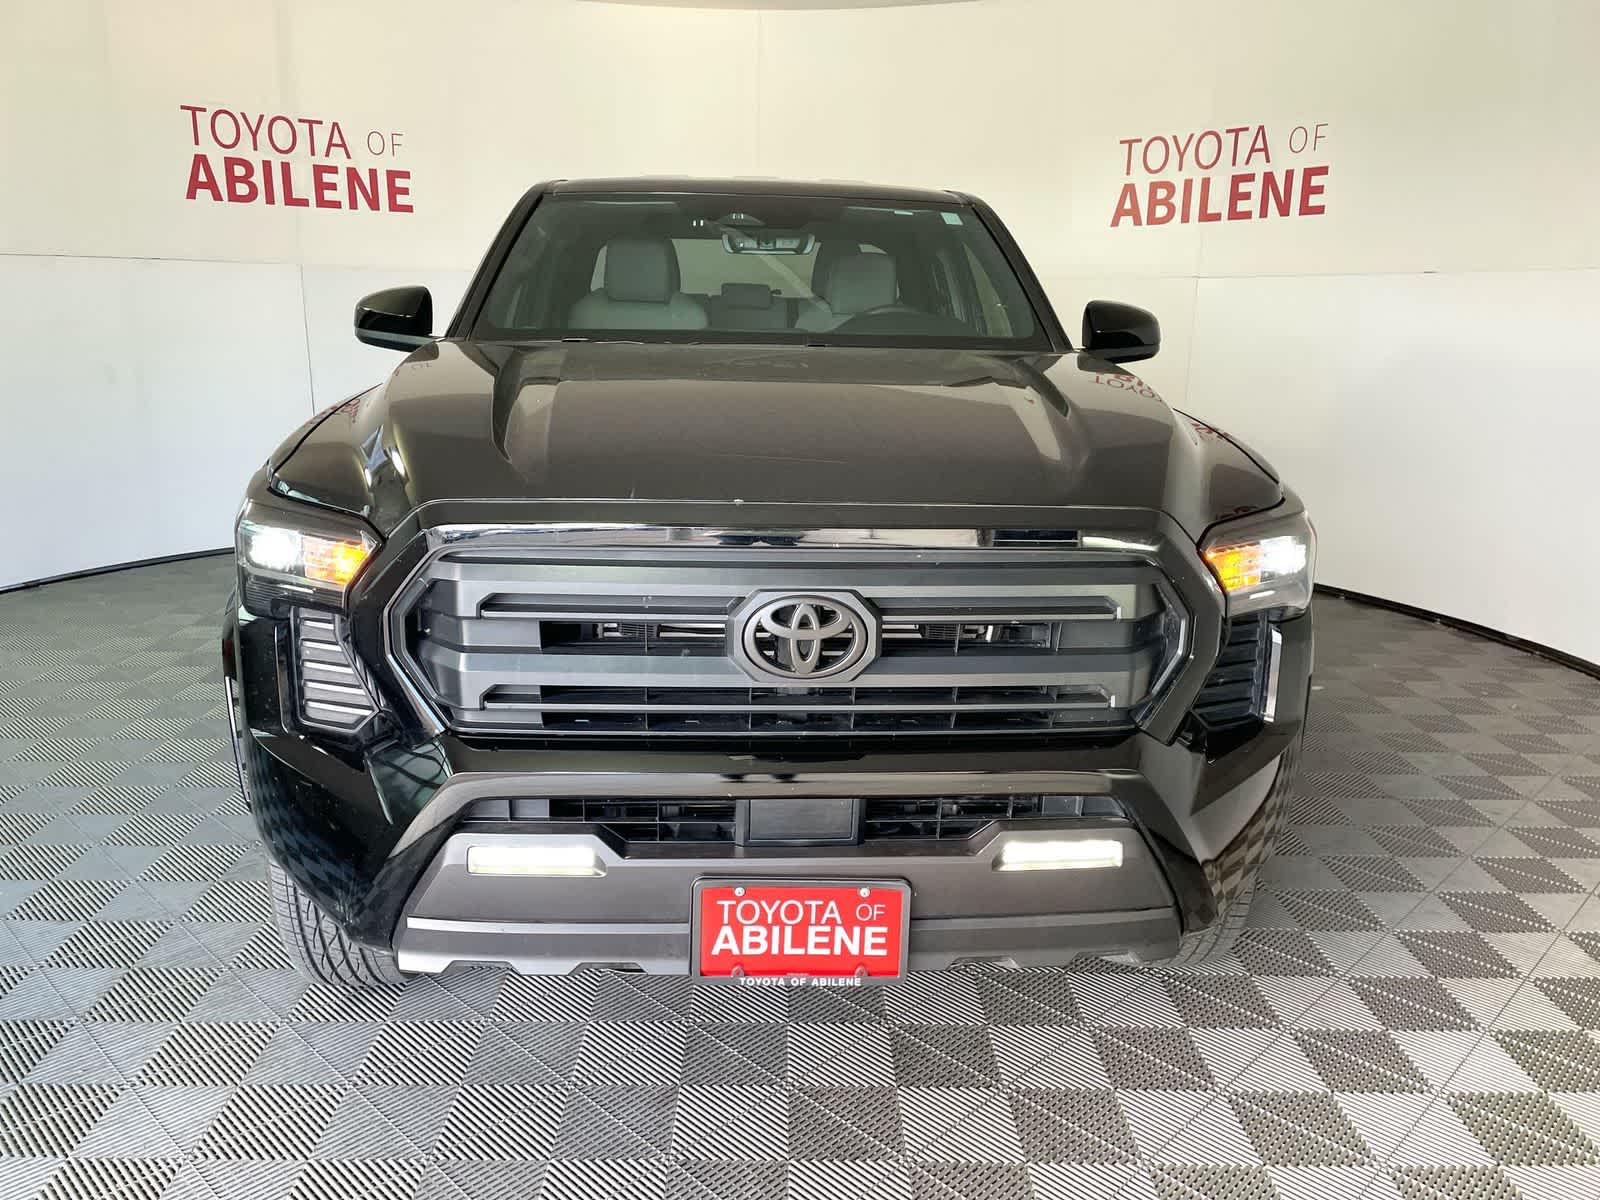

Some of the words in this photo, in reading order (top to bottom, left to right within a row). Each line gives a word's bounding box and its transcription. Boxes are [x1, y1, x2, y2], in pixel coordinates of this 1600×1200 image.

[180, 104, 352, 159] TOYOTA
[367, 130, 404, 157] OF
[1119, 124, 1271, 176] TOYOTA
[1288, 123, 1329, 154] OF
[186, 153, 414, 213] ABILENE
[1110, 165, 1329, 228] ABILENE
[716, 899, 842, 925] TOYOTA
[856, 903, 886, 922] OF
[711, 925, 889, 956] ABILENE
[739, 977, 786, 987] TOYOTA
[790, 977, 807, 987] OF
[811, 977, 862, 987] ABILENE
